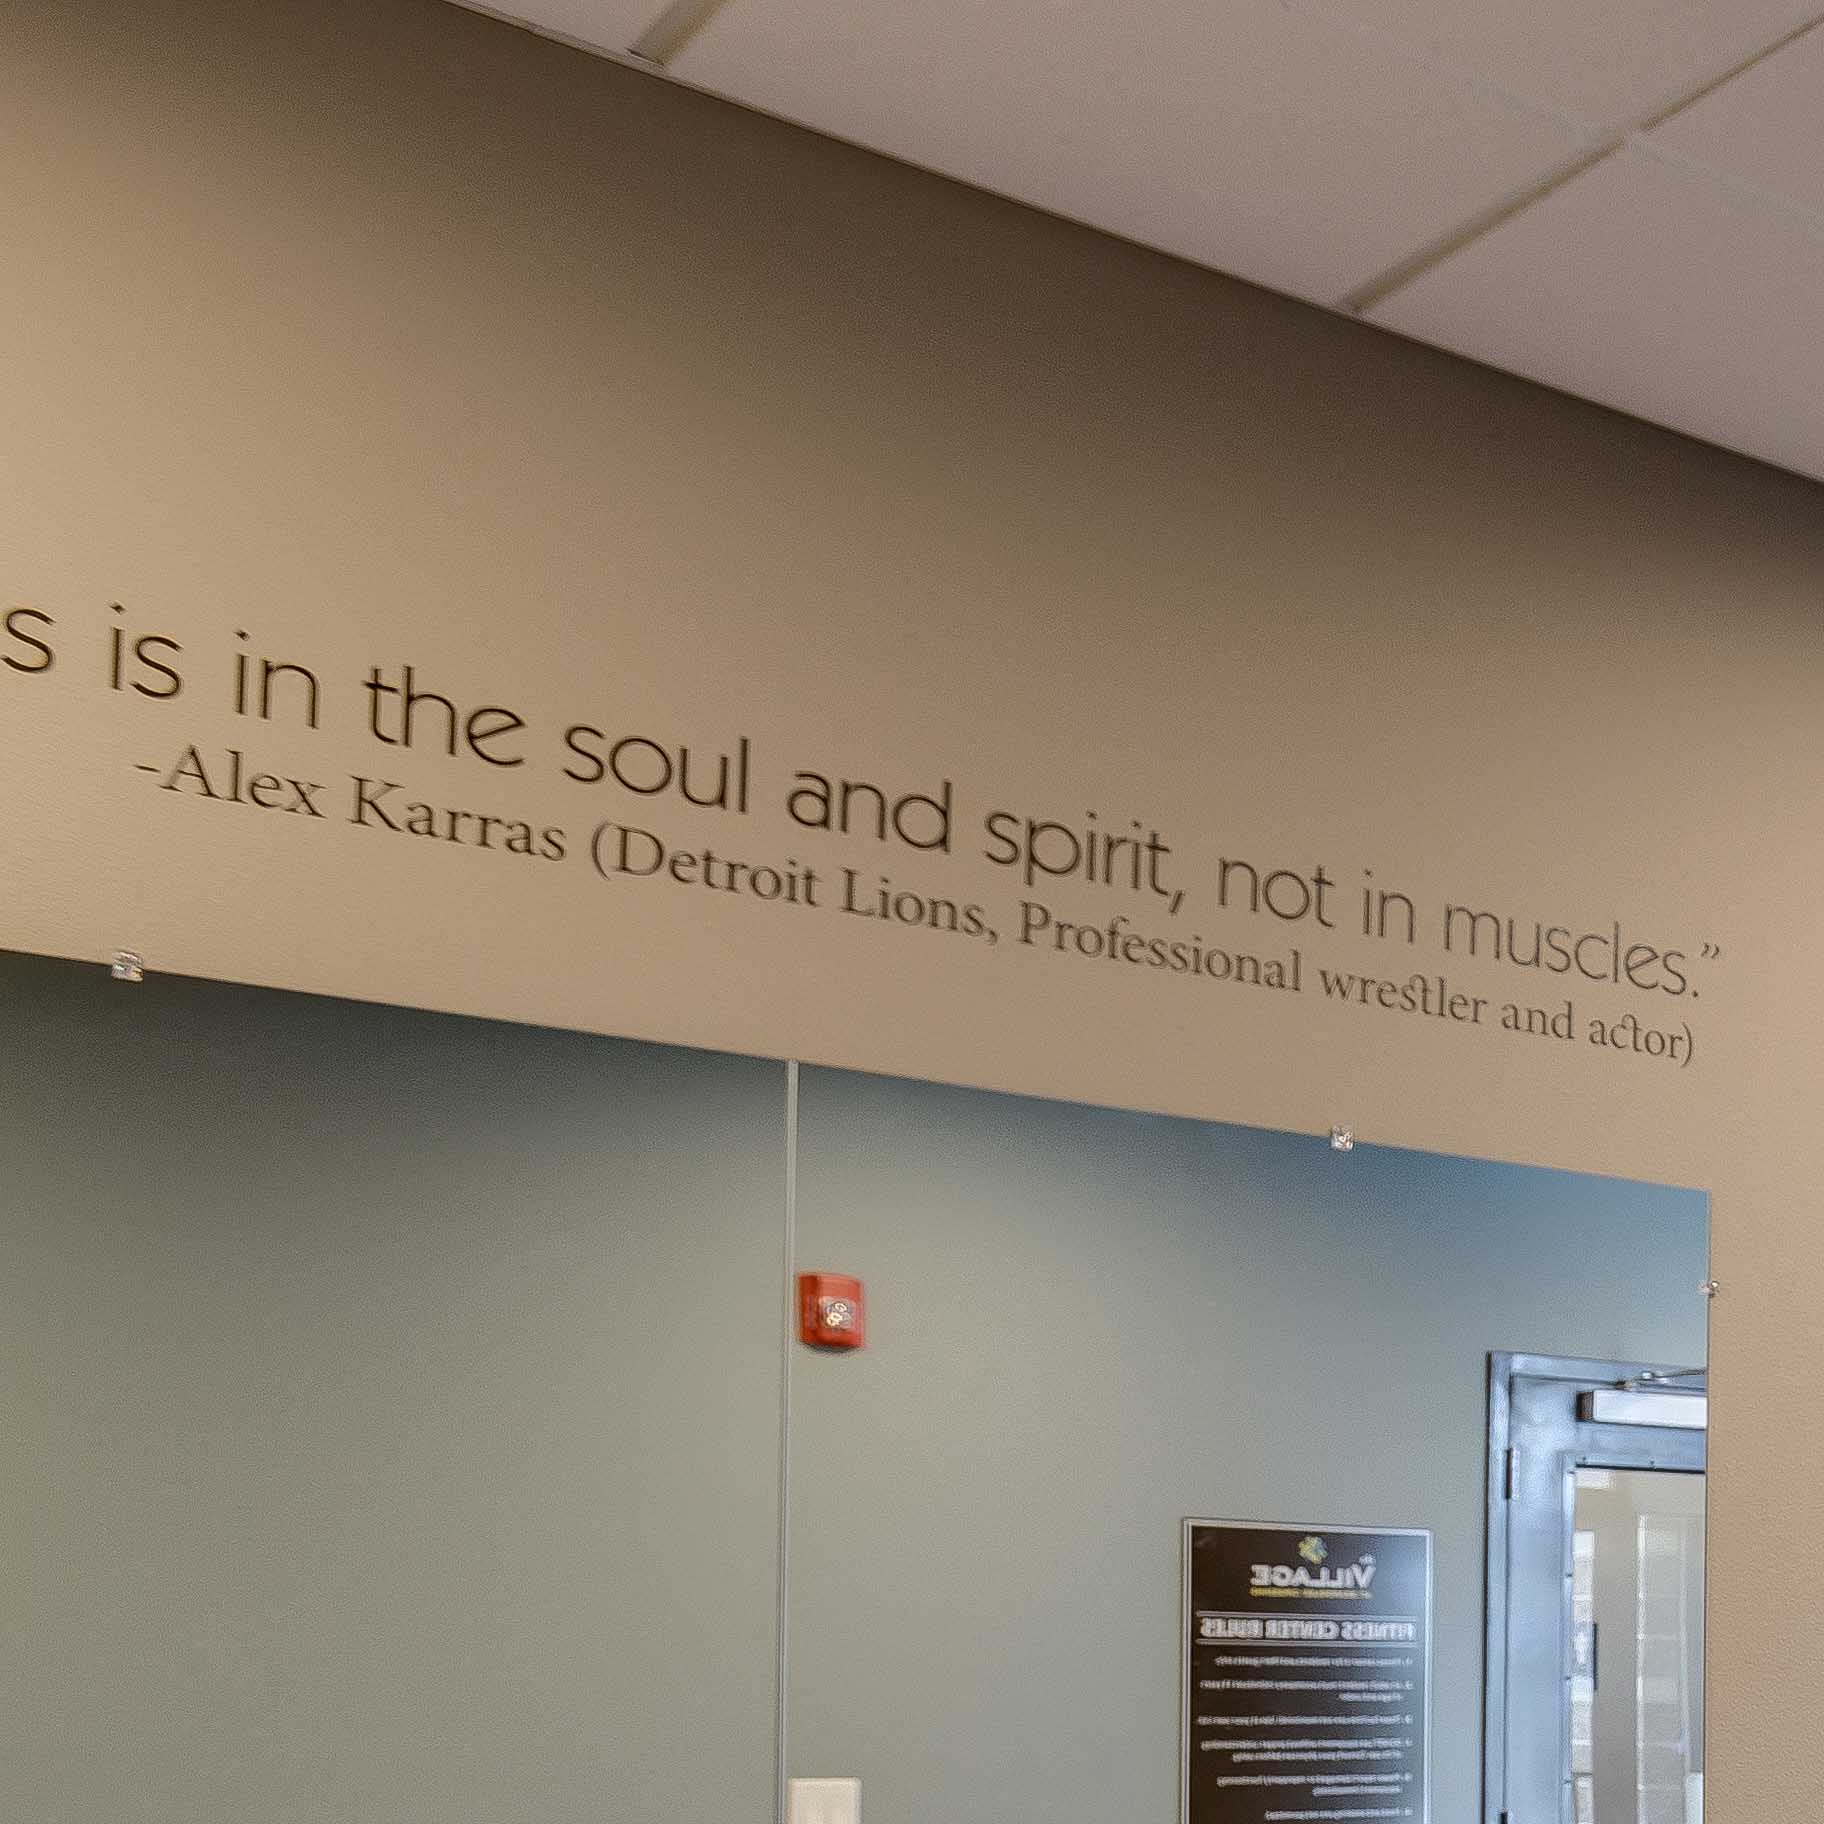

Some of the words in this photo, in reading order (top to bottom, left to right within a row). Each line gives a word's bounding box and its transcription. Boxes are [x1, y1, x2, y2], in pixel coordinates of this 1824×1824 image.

[108, 602, 185, 700] is
[233, 628, 321, 730] in
[362, 664, 526, 767] the
[564, 723, 752, 814] soul
[787, 768, 953, 855] and
[983, 807, 1187, 915] spirit,
[1217, 853, 1337, 931] not
[1362, 867, 1417, 944] in
[133, 743, 329, 820] -Alex
[349, 775, 567, 863] Karras
[589, 820, 819, 908] (Detroit
[840, 866, 999, 945] Lions,
[1019, 900, 1302, 994] Professional
[1319, 972, 1488, 1028] wrestler
[1501, 1002, 1575, 1043] and
[1588, 1012, 1695, 1069] actor)
